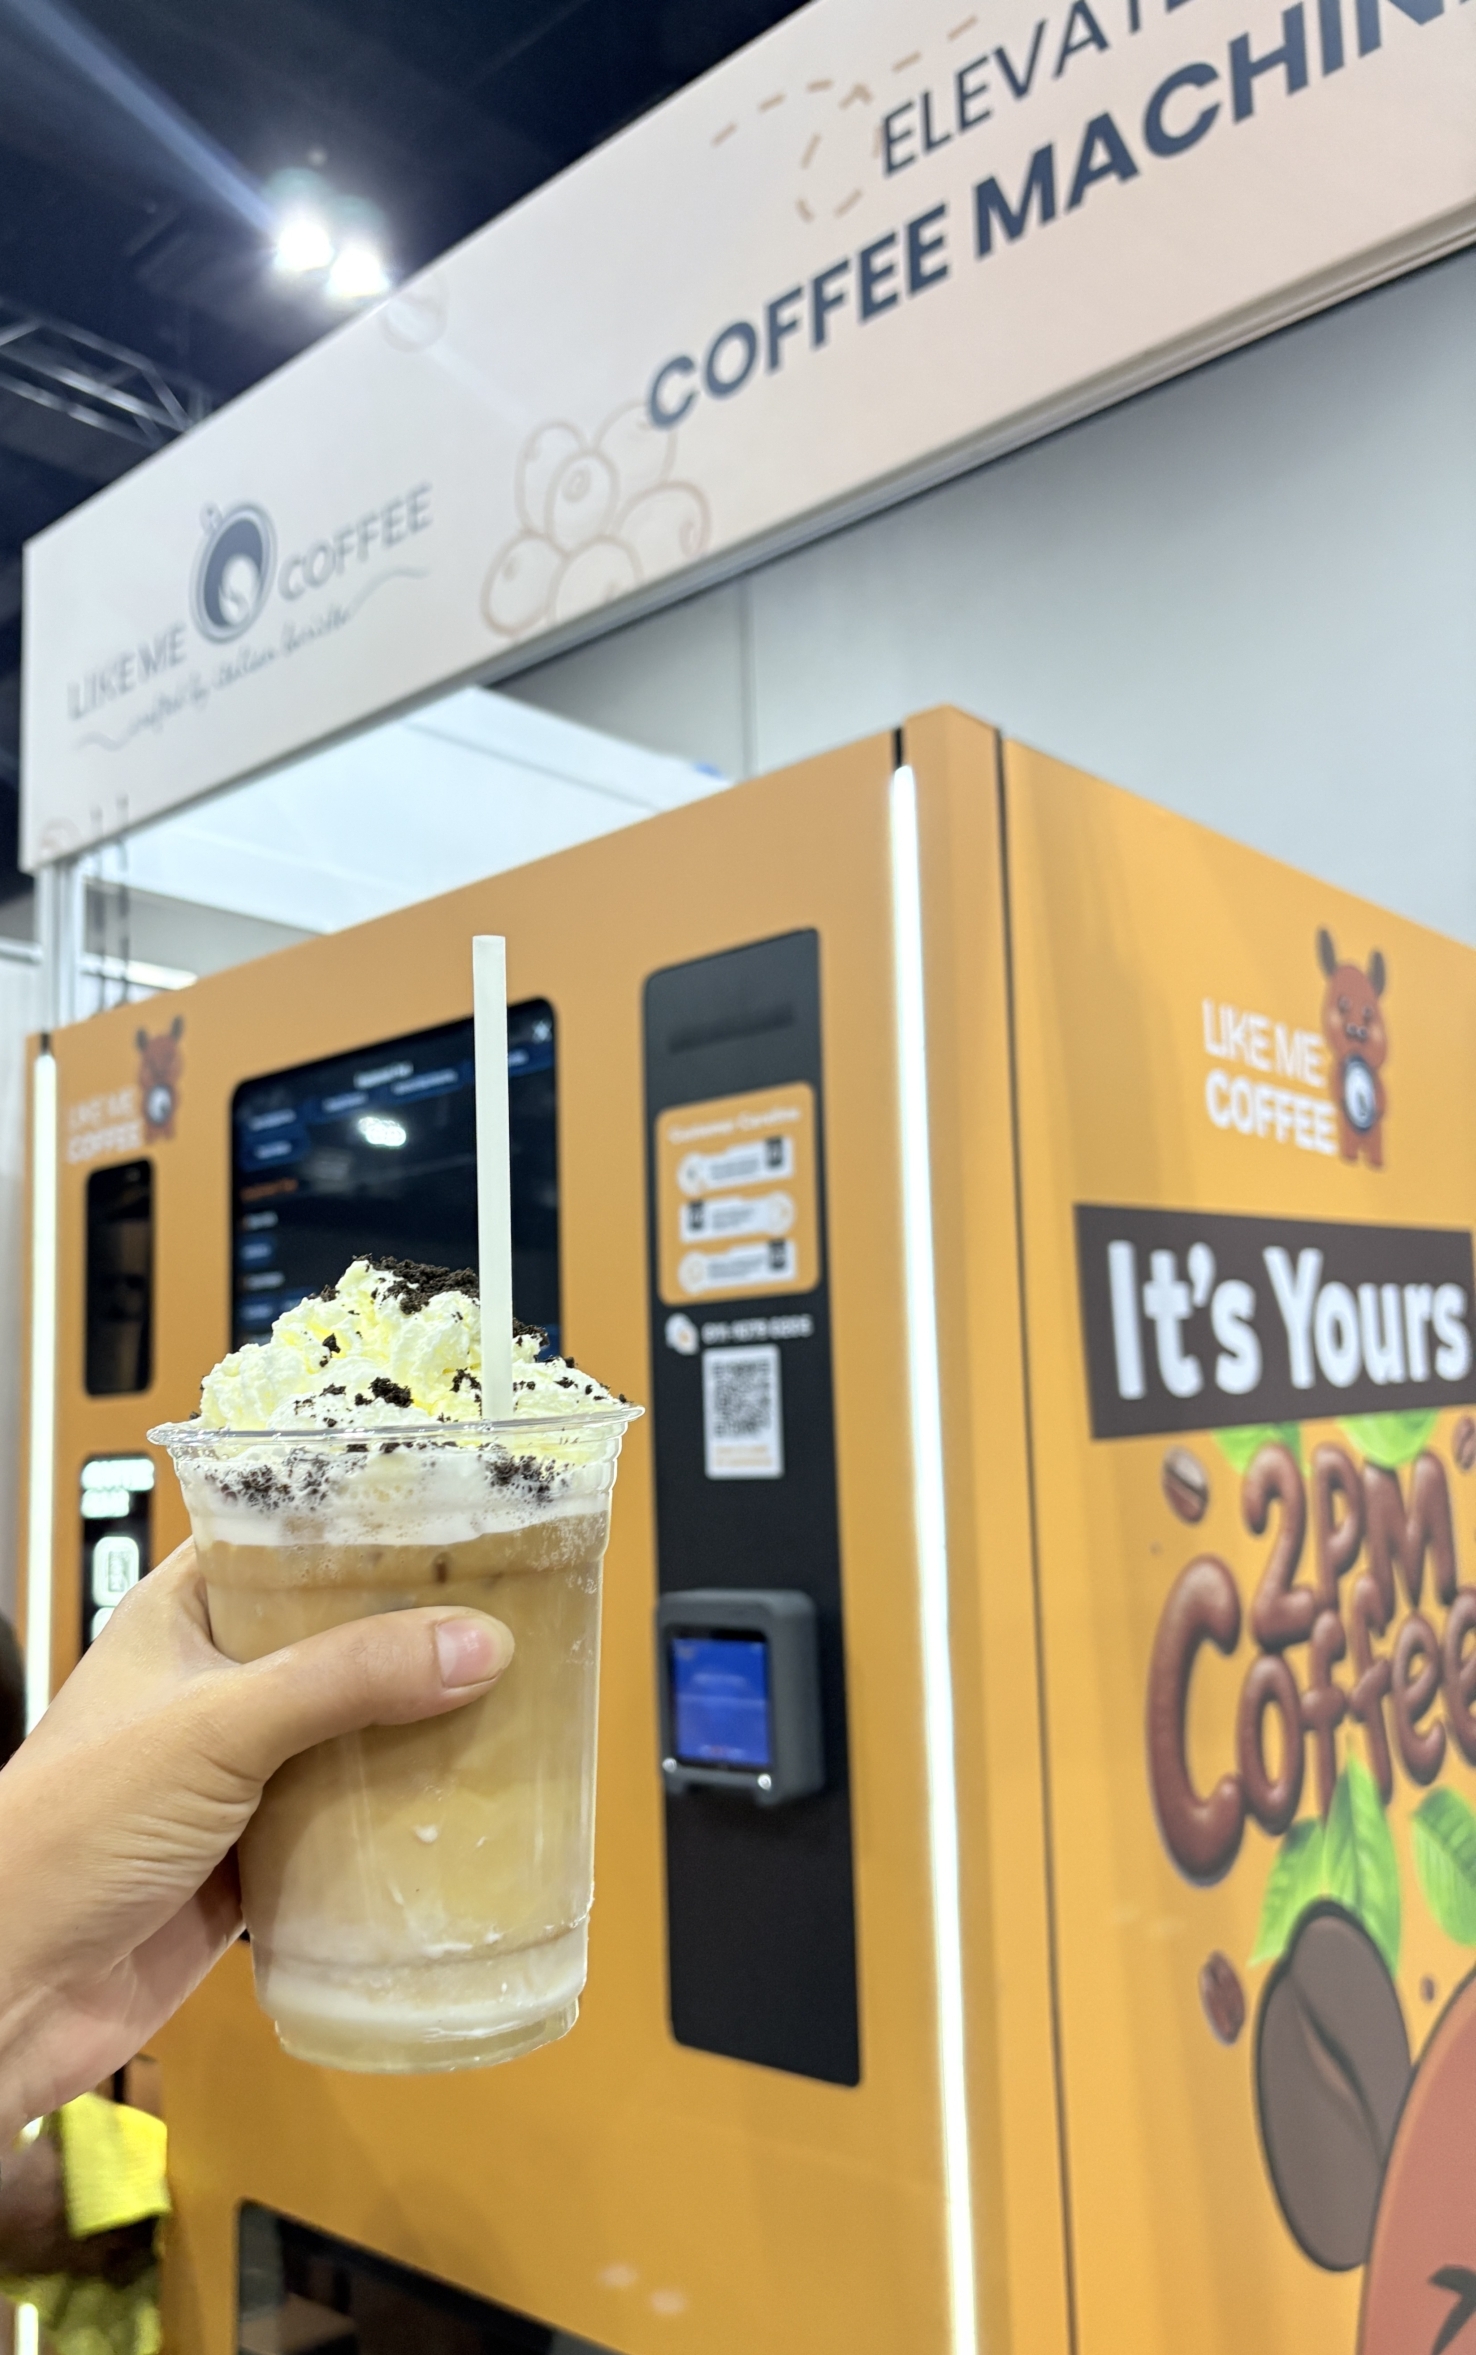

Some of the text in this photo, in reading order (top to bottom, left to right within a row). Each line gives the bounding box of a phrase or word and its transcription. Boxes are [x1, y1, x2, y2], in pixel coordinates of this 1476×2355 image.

[882, 0, 1197, 178] ELEVA
[645, 0, 1476, 432] COFFEE MACHIN
[67, 480, 434, 721] LIKE ME COFFEE
[1202, 998, 1327, 1089] LIKE ME
[1205, 1068, 1339, 1157] COFFEE
[1262, 1245, 1472, 1389] Yours
[1243, 1441, 1459, 1655] 2PM
